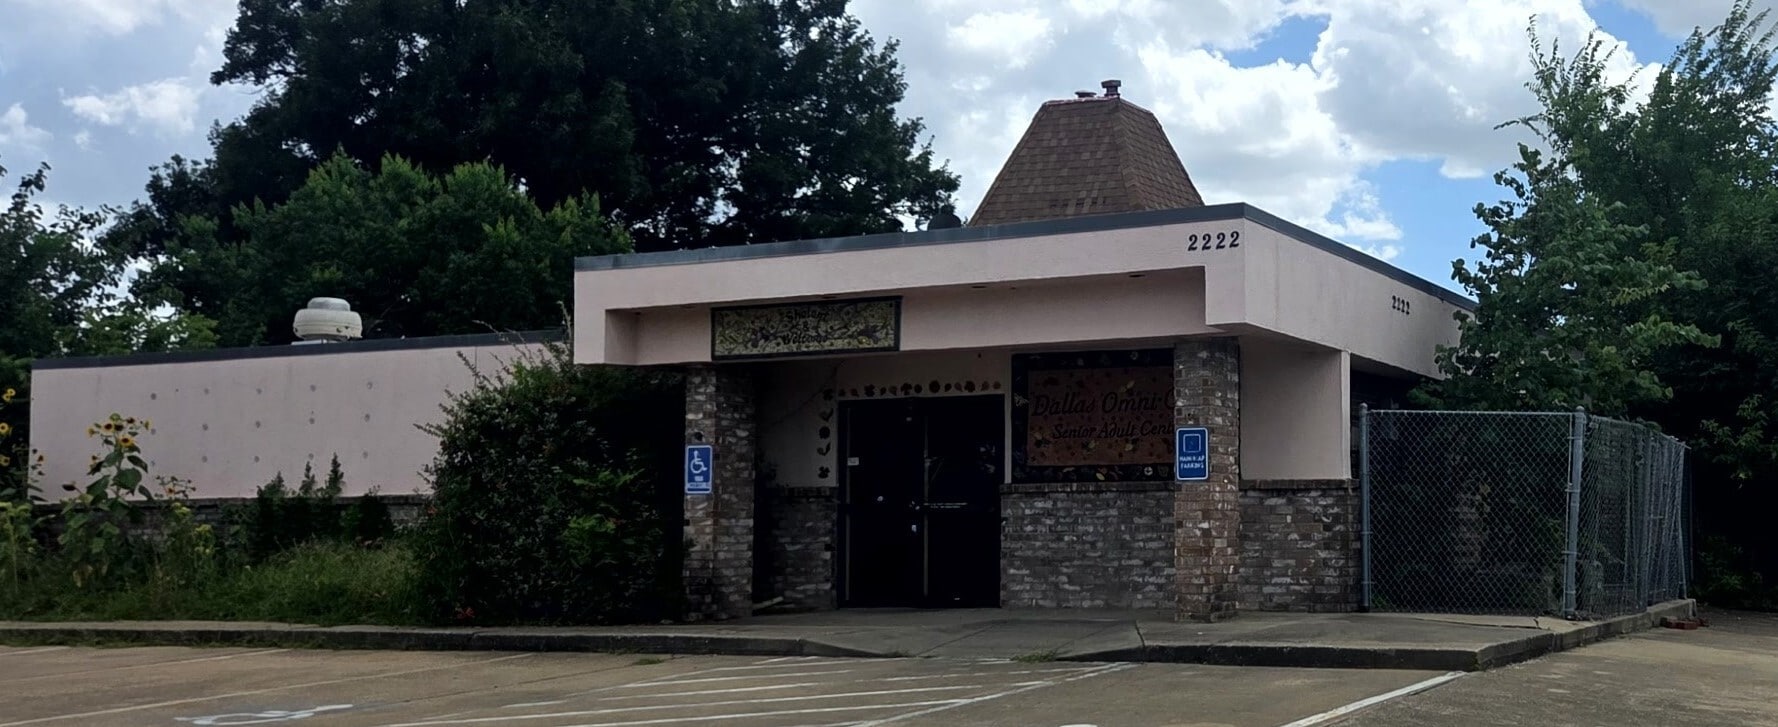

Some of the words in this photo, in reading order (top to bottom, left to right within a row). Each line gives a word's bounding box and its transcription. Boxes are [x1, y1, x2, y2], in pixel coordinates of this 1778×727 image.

[1187, 231, 1240, 251] 2222
[1031, 392, 1095, 416] Dallas
[1052, 423, 1096, 439] Senior
[1097, 421, 1134, 438] Adult
